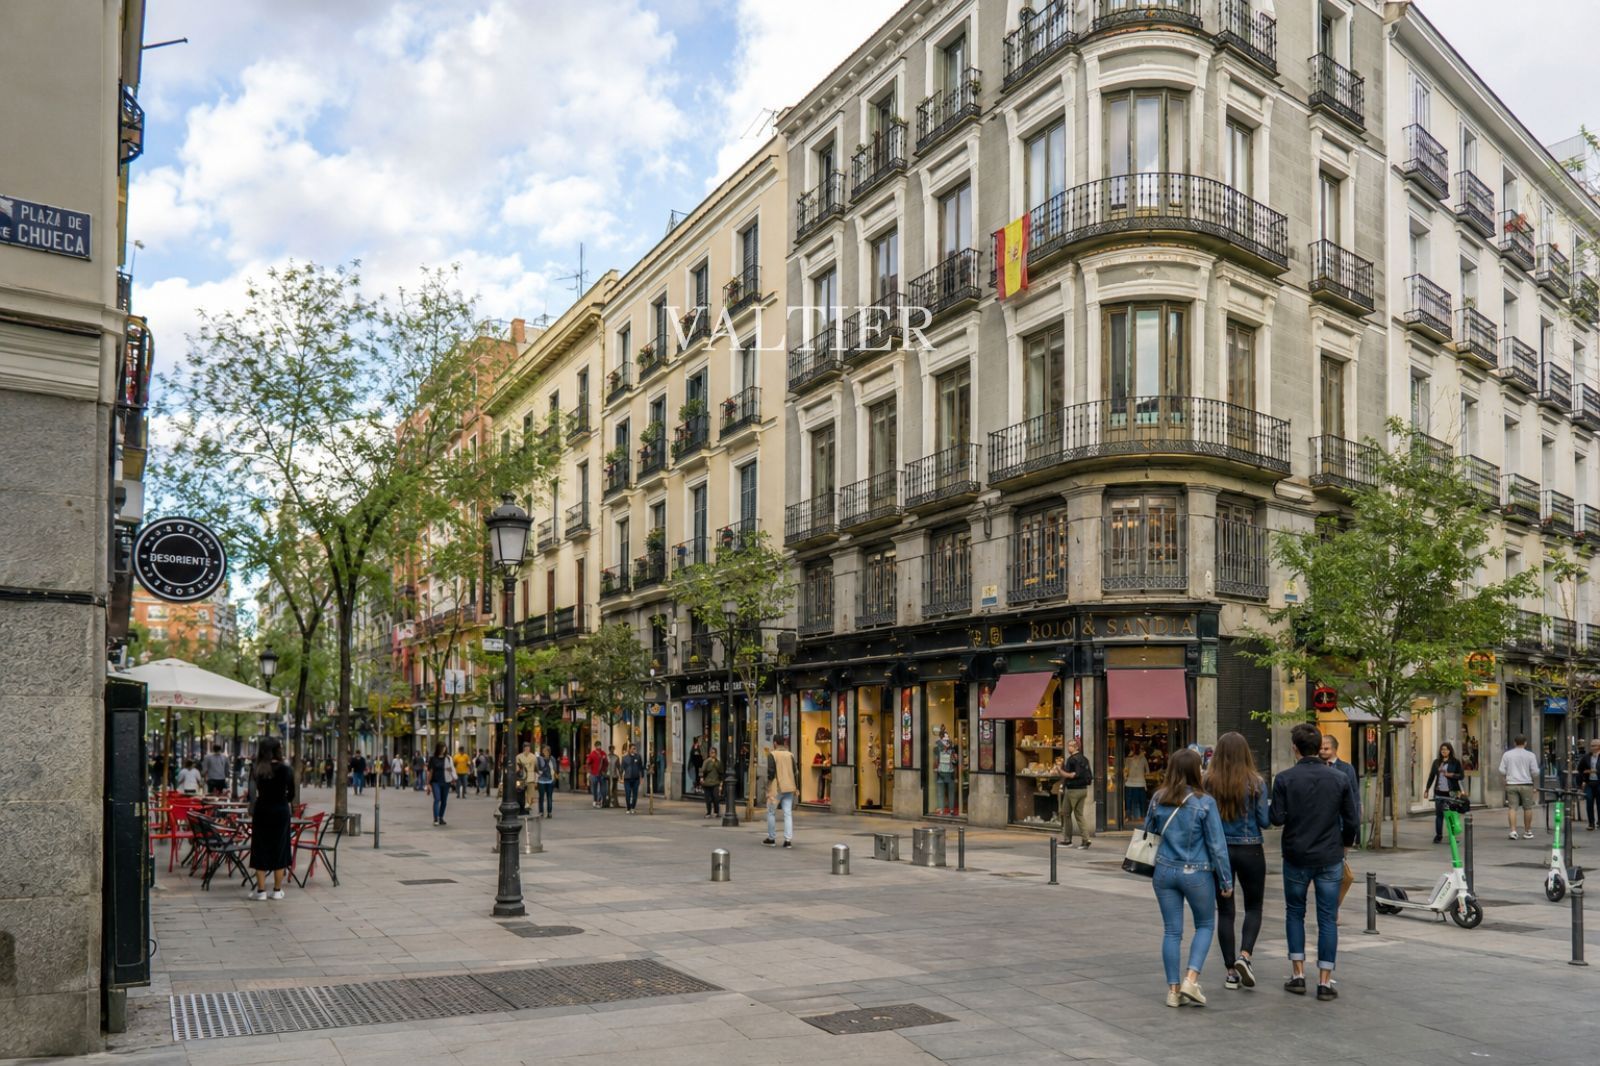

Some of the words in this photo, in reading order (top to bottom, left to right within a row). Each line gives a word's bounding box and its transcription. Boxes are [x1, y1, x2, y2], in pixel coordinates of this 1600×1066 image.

[21, 204, 60, 227] PLAZA
[68, 215, 82, 230] DE
[18, 223, 85, 254] CHUECA
[149, 553, 211, 567] DESORIENTE
[1031, 620, 1073, 640] ROJO
[1082, 619, 1096, 635] &
